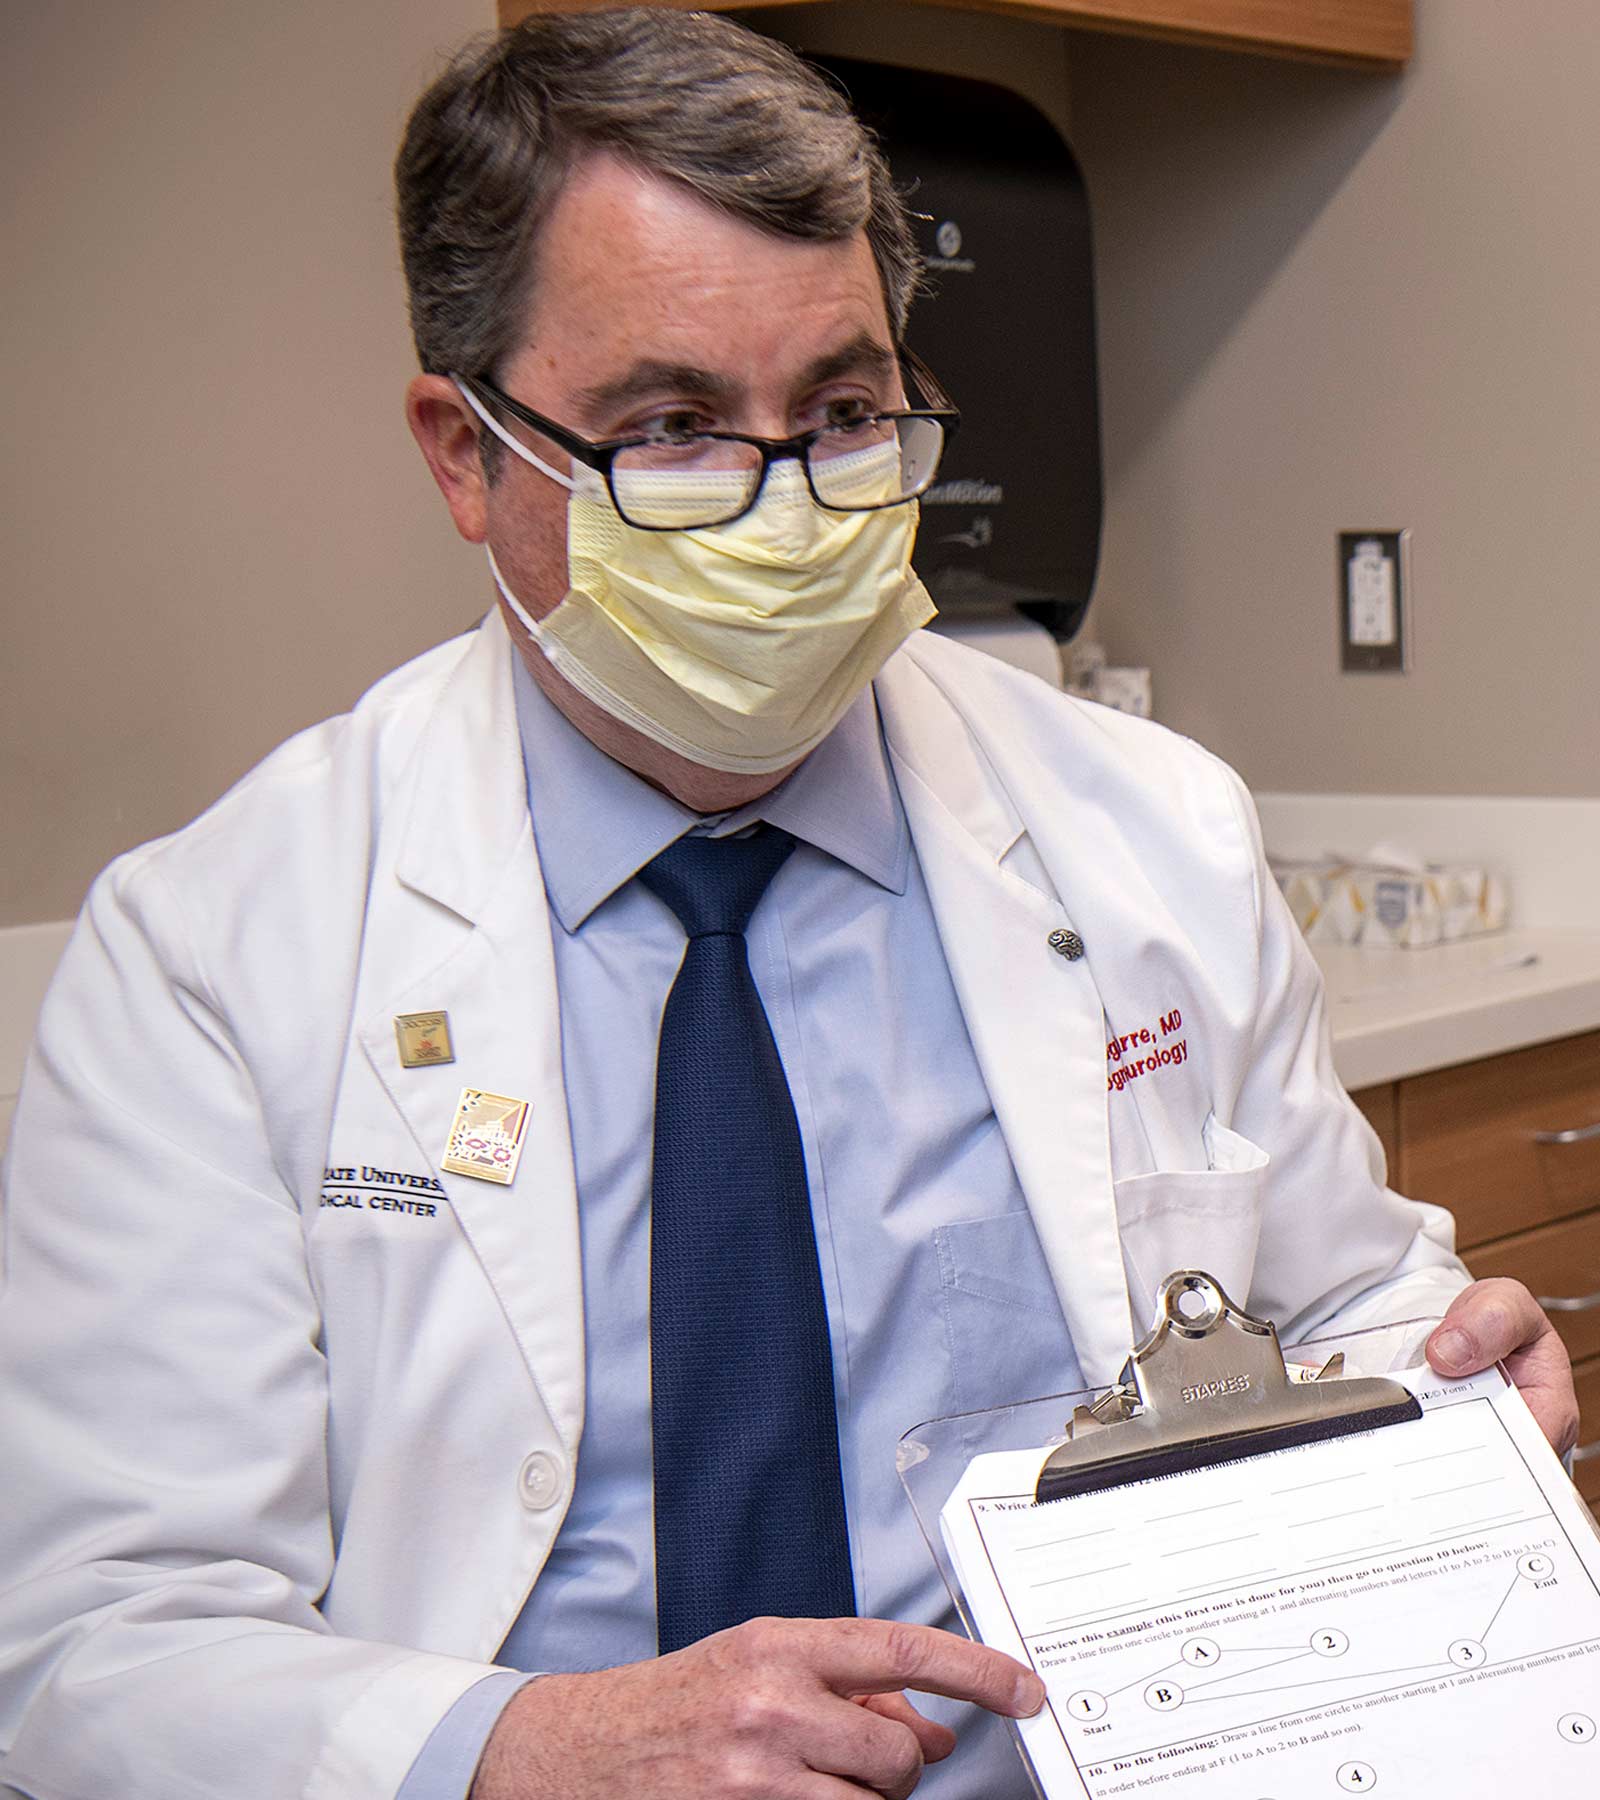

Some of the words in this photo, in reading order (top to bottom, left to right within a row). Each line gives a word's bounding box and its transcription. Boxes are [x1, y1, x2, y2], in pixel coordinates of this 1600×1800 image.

[1159, 1009, 1182, 1036] MD
[368, 1196, 437, 1218] CENTER
[1181, 1375, 1250, 1404] STAPLES
[1442, 1384, 1467, 1396] Form
[977, 1504, 989, 1513] 9.
[993, 1501, 1027, 1513] Write
[1527, 1558, 1544, 1573] C
[1533, 1577, 1558, 1590] End
[1034, 1638, 1078, 1655] Review
[1081, 1629, 1104, 1645] this
[1106, 1620, 1154, 1640] example
[1155, 1612, 1183, 1627] (this
[1184, 1605, 1210, 1619] first
[1212, 1600, 1234, 1612] one
[1235, 1596, 1246, 1606] is
[1248, 1591, 1277, 1604] done
[1278, 1586, 1296, 1597] for
[1299, 1579, 1326, 1593] you)
[1327, 1573, 1354, 1585] then
[1356, 1569, 1370, 1581] go
[1371, 1566, 1384, 1575] to
[1386, 1553, 1434, 1573] question
[1436, 1550, 1450, 1560] 10
[1039, 1656, 1067, 1669] Draw
[1070, 1655, 1076, 1663] a
[1078, 1648, 1097, 1661] line
[1098, 1642, 1124, 1656] from
[1125, 1640, 1143, 1650] one
[1144, 1630, 1172, 1645] circle
[1173, 1628, 1183, 1638] to
[1185, 1618, 1221, 1634] another
[1222, 1610, 1259, 1626] starting
[1260, 1607, 1270, 1616] at
[1271, 1605, 1277, 1613] 1
[1279, 1600, 1298, 1611] and
[1299, 1588, 1349, 1607] alternating
[1350, 1580, 1390, 1596] numbers
[1391, 1574, 1408, 1586] and
[1409, 1567, 1438, 1582] letters
[1439, 1564, 1449, 1575] (1
[1450, 1562, 1461, 1571] to
[1462, 1559, 1473, 1568] A
[1473, 1557, 1483, 1566] to
[1484, 1554, 1492, 1563] 2
[1492, 1551, 1502, 1561] to
[1502, 1549, 1513, 1559] B
[1513, 1547, 1524, 1556] to
[1532, 1542, 1542, 1551] to
[1322, 1635, 1336, 1649] 2
[1194, 1646, 1209, 1660] A
[1459, 1647, 1473, 1661] 3
[1156, 1688, 1172, 1703] B
[1081, 1698, 1092, 1713] 1
[1087, 1767, 1107, 1778] 10.
[1113, 1760, 1132, 1772] Do
[1134, 1754, 1155, 1768] the
[1156, 1738, 1220, 1761] following:
[1221, 1730, 1249, 1744] Draw
[1250, 1729, 1257, 1737] a
[1258, 1723, 1278, 1735] line
[1279, 1717, 1304, 1730] from
[1305, 1712, 1323, 1723] one
[1324, 1704, 1352, 1719] circle
[1352, 1701, 1363, 1711] to
[1365, 1693, 1400, 1709] another
[1401, 1684, 1438, 1700] starting
[1438, 1680, 1448, 1690] at
[1449, 1679, 1455, 1687] 1
[1457, 1674, 1476, 1686] and
[1477, 1662, 1526, 1682] alternating
[1526, 1653, 1566, 1669] numbers
[1567, 1647, 1585, 1659] and
[1082, 1723, 1113, 1737] Start
[1571, 1721, 1584, 1736] 6
[1095, 1788, 1107, 1798] in
[1108, 1780, 1137, 1795] order
[1137, 1772, 1170, 1788] before
[1172, 1761, 1207, 1779] ending
[1208, 1758, 1218, 1769] at
[1218, 1756, 1229, 1767] F
[1228, 1752, 1241, 1766] (1
[1242, 1749, 1253, 1760] to
[1254, 1747, 1266, 1758] A
[1266, 1744, 1277, 1755] to
[1277, 1741, 1287, 1751] 2
[1287, 1738, 1299, 1748] to
[1299, 1735, 1309, 1745] B
[1310, 1730, 1330, 1743] and
[1330, 1728, 1343, 1738] so
[1351, 1769, 1363, 1783] 4
